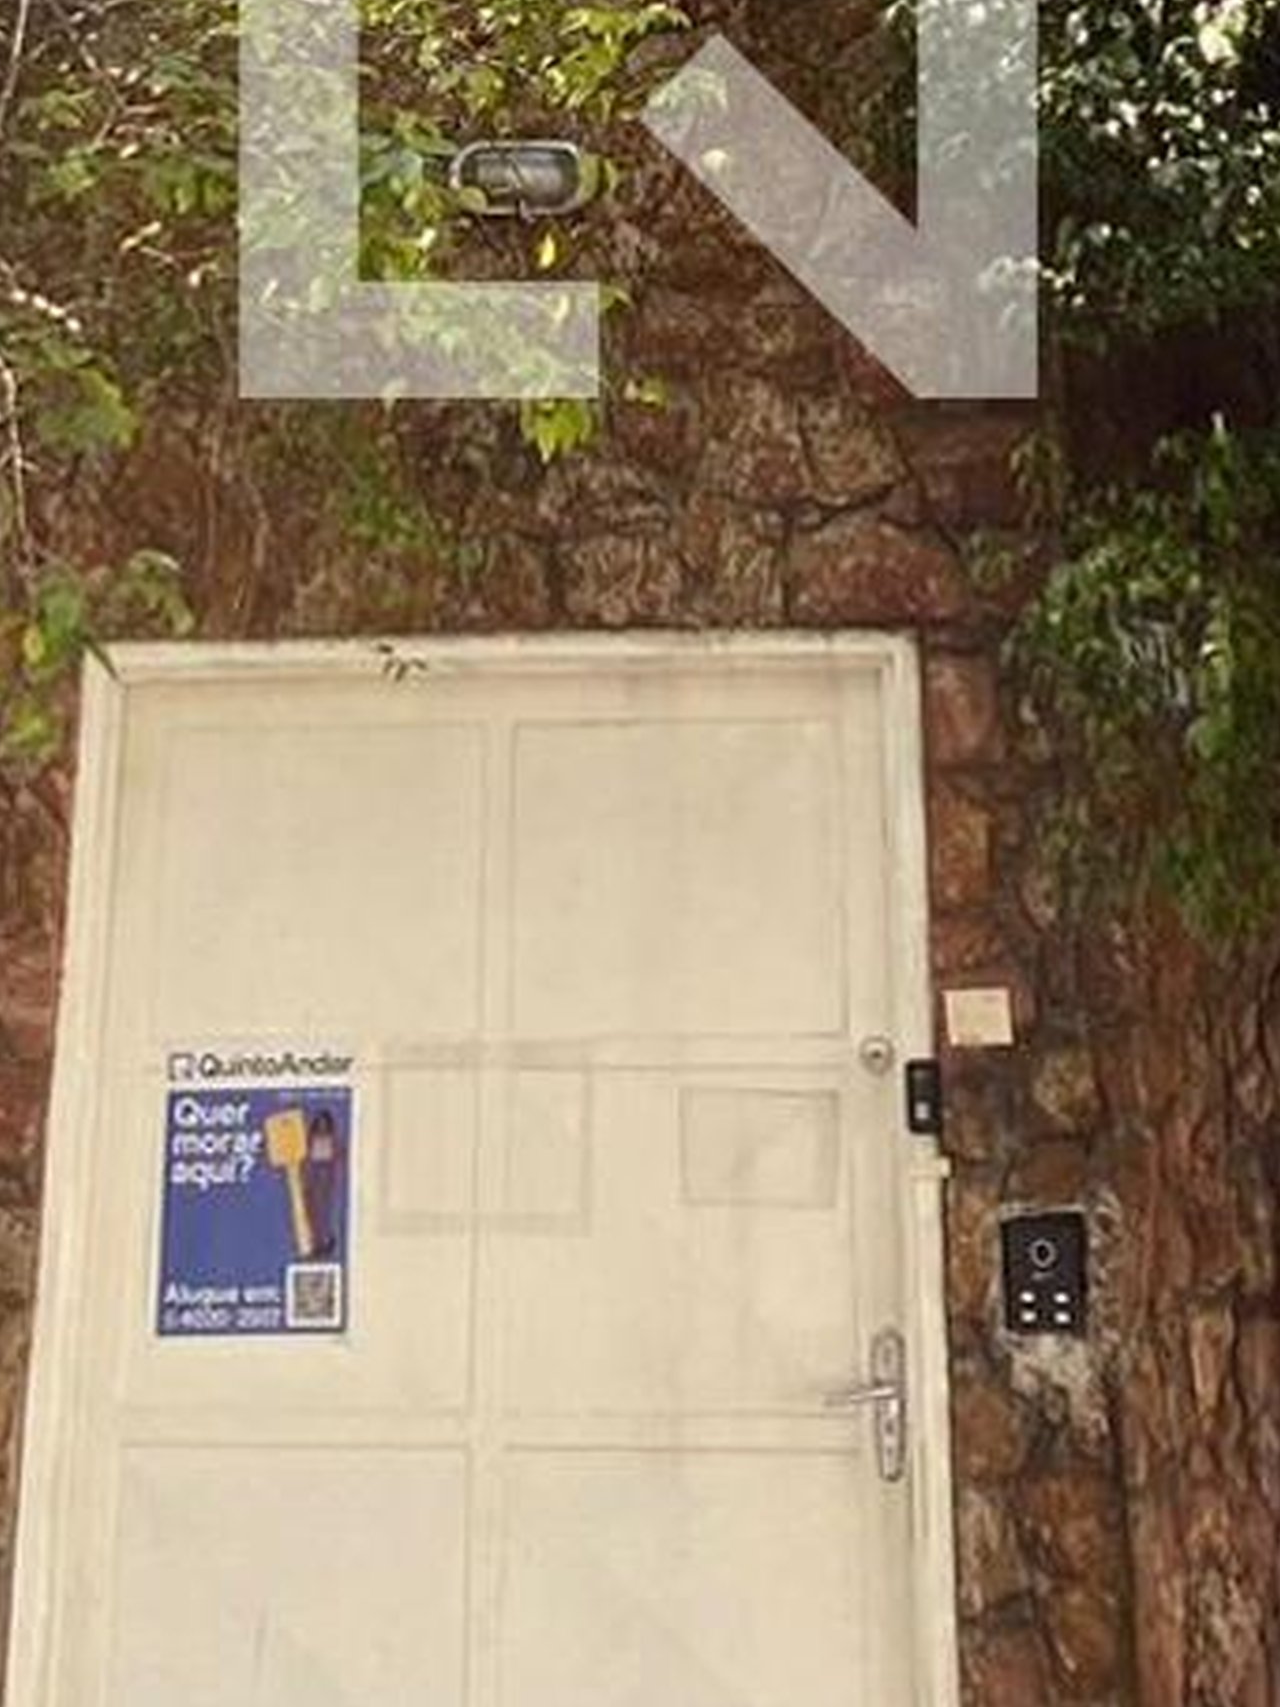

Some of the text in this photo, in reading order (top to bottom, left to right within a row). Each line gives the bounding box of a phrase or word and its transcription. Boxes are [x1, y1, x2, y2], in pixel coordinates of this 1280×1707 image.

[199, 1052, 354, 1077] QuintoAndar
[174, 1097, 250, 1127] Quer
[171, 1153, 255, 1190] aqui?
